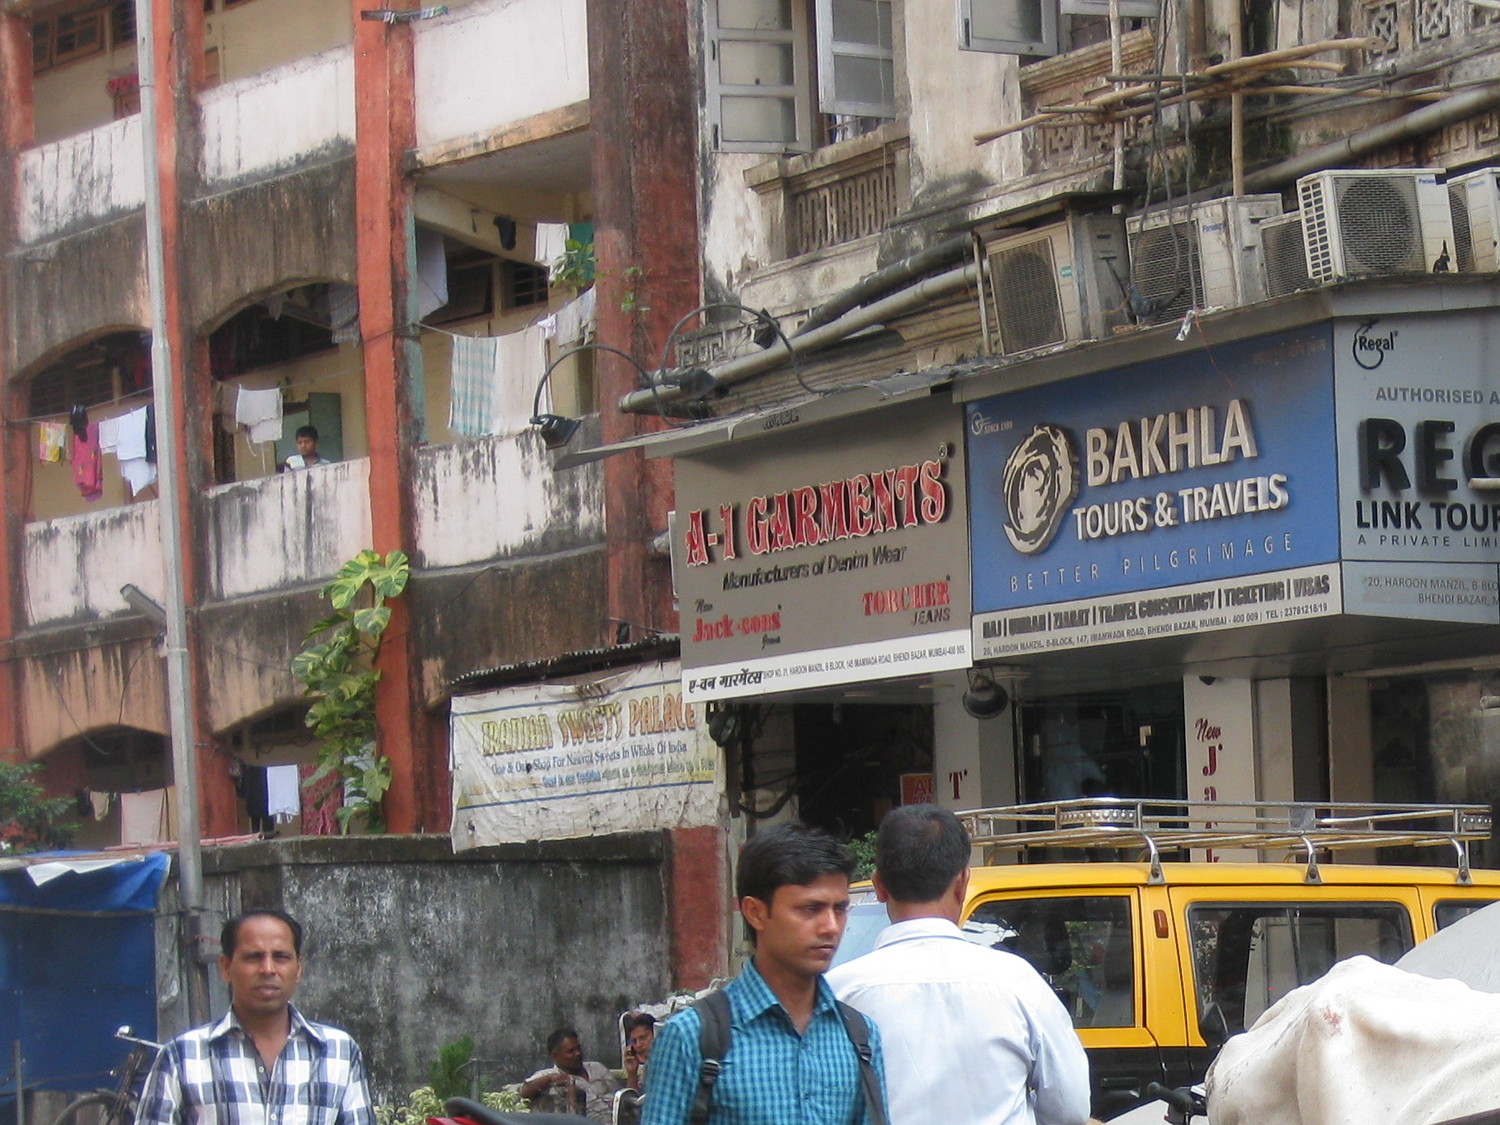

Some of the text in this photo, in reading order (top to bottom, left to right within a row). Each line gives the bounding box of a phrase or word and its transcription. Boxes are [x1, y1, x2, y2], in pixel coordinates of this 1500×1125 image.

[1356, 330, 1395, 358] Regal
[1376, 387, 1484, 405] AUTHORISED
[1086, 399, 1258, 487] BAKHLA
[685, 459, 946, 568] A-1 GARMENTS
[1073, 474, 1289, 541] TOURS & TRAVELS
[1356, 500, 1422, 530] LINK
[1358, 534, 1367, 545] A
[1380, 535, 1450, 547] PRIVATE
[723, 545, 907, 591] Manufacturers of Denim Wear
[1010, 532, 1293, 593] BETTER PILGRIMAGE
[1384, 577, 1427, 589] HAROON
[863, 580, 951, 617] TORCHER
[1098, 602, 1137, 624] TRAVEL
[1139, 588, 1216, 619] CONSULTANCY
[1223, 581, 1285, 607] TICKETING
[1293, 574, 1331, 598] VISAS
[1418, 593, 1455, 604] BHENDI
[911, 607, 951, 627] JEANS
[1195, 718, 1221, 742] New
[668, 739, 688, 754] India
